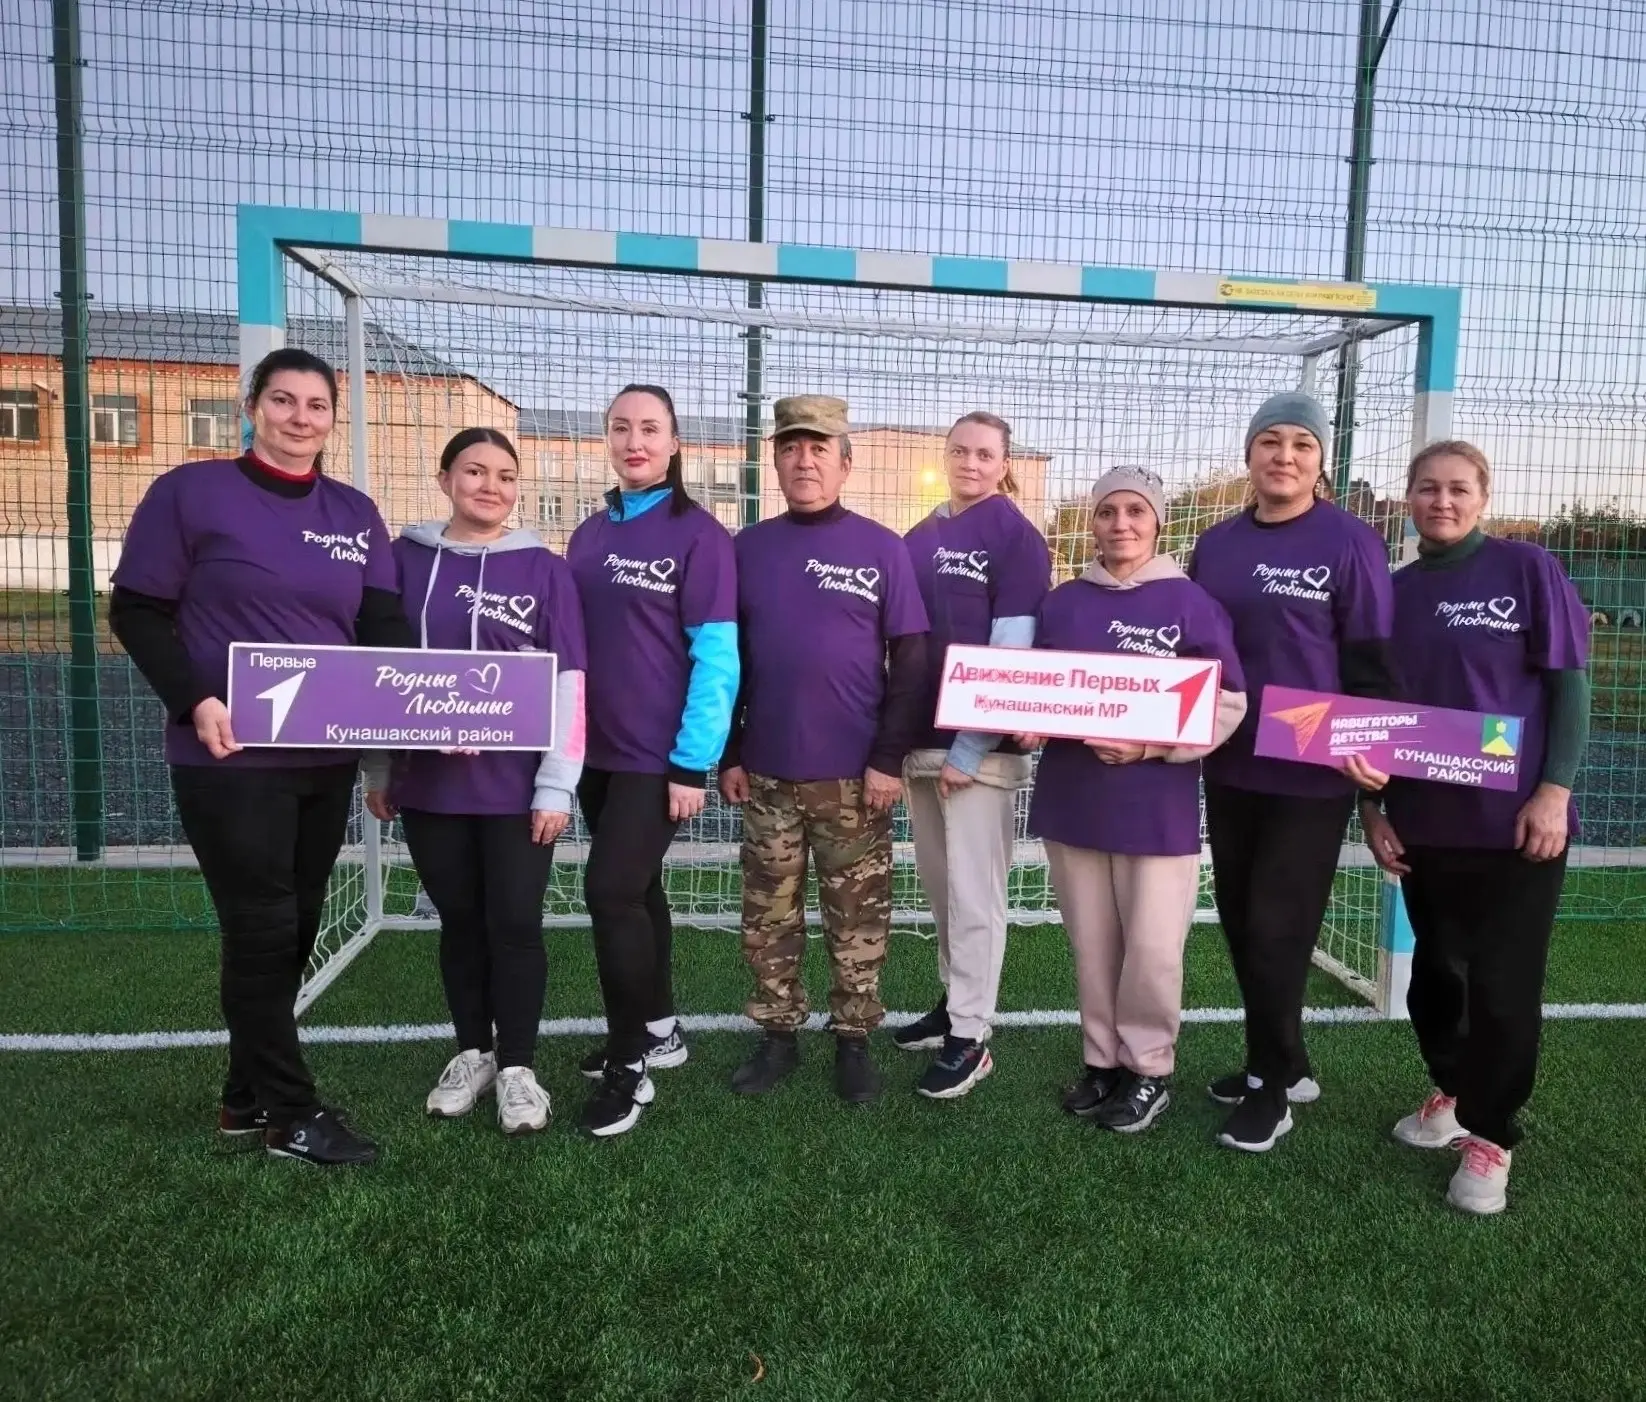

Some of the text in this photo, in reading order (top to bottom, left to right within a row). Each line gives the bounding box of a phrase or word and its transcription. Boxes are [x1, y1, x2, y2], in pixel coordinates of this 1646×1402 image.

[302, 530, 353, 548] Родные
[331, 546, 366, 565] Люби
[604, 554, 648, 571] Родные
[805, 559, 854, 577] Родные
[1252, 564, 1300, 581] Родные
[611, 570, 676, 593] Любимые
[1262, 580, 1330, 601] Любимые
[1435, 601, 1485, 617] Родные
[1107, 620, 1155, 637] Родные
[1447, 612, 1520, 632] Любимые
[1116, 637, 1177, 657] Любимы
[250, 652, 317, 671] Первые
[375, 665, 458, 696] Родные
[949, 662, 1160, 694] Движение Первых
[405, 691, 514, 716] Любимые
[974, 694, 1128, 718] Кунашакский МР
[326, 723, 514, 744] Кунашакский район
[1328, 730, 1389, 746] ДЕТСТВА
[1393, 747, 1516, 775] КУНАШАКСКИЙ
[1427, 764, 1483, 784] РАЙОН
